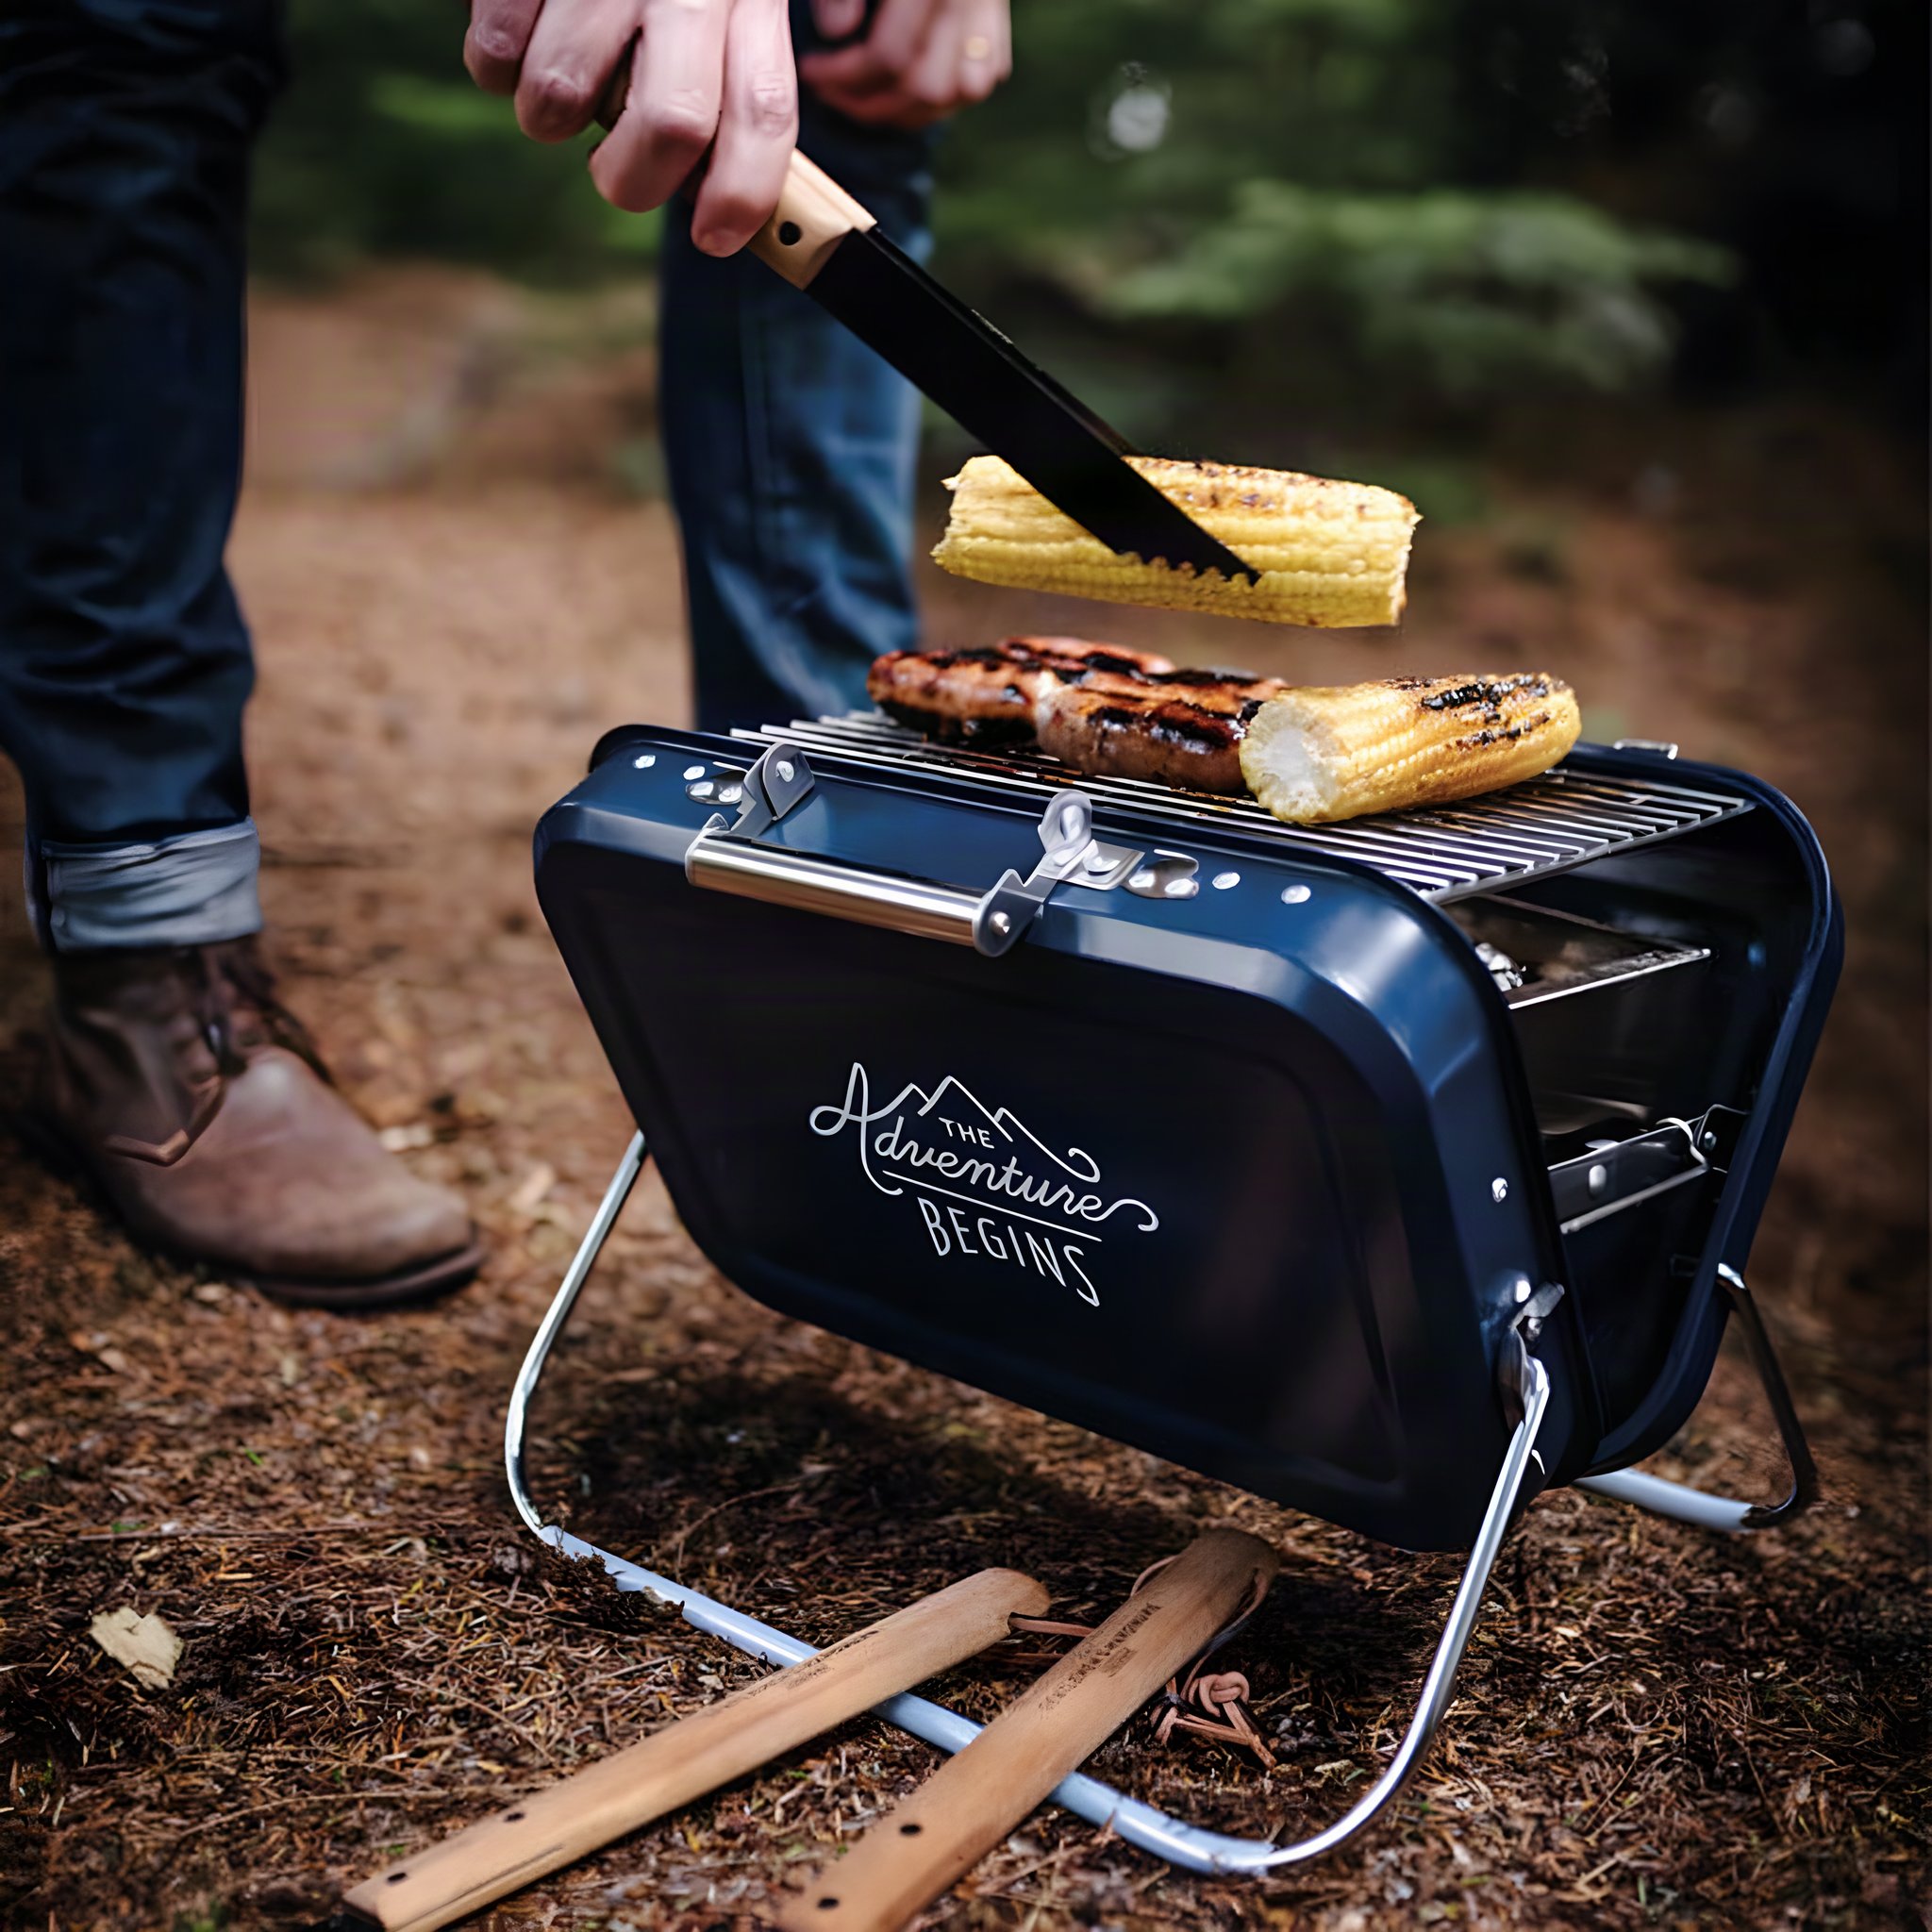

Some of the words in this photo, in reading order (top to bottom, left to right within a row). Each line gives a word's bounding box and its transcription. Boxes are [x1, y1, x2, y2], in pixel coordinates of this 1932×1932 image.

[808, 1062, 1159, 1231] Adventure
[938, 1116, 995, 1149] THE
[917, 1196, 1101, 1307] BEGINS
